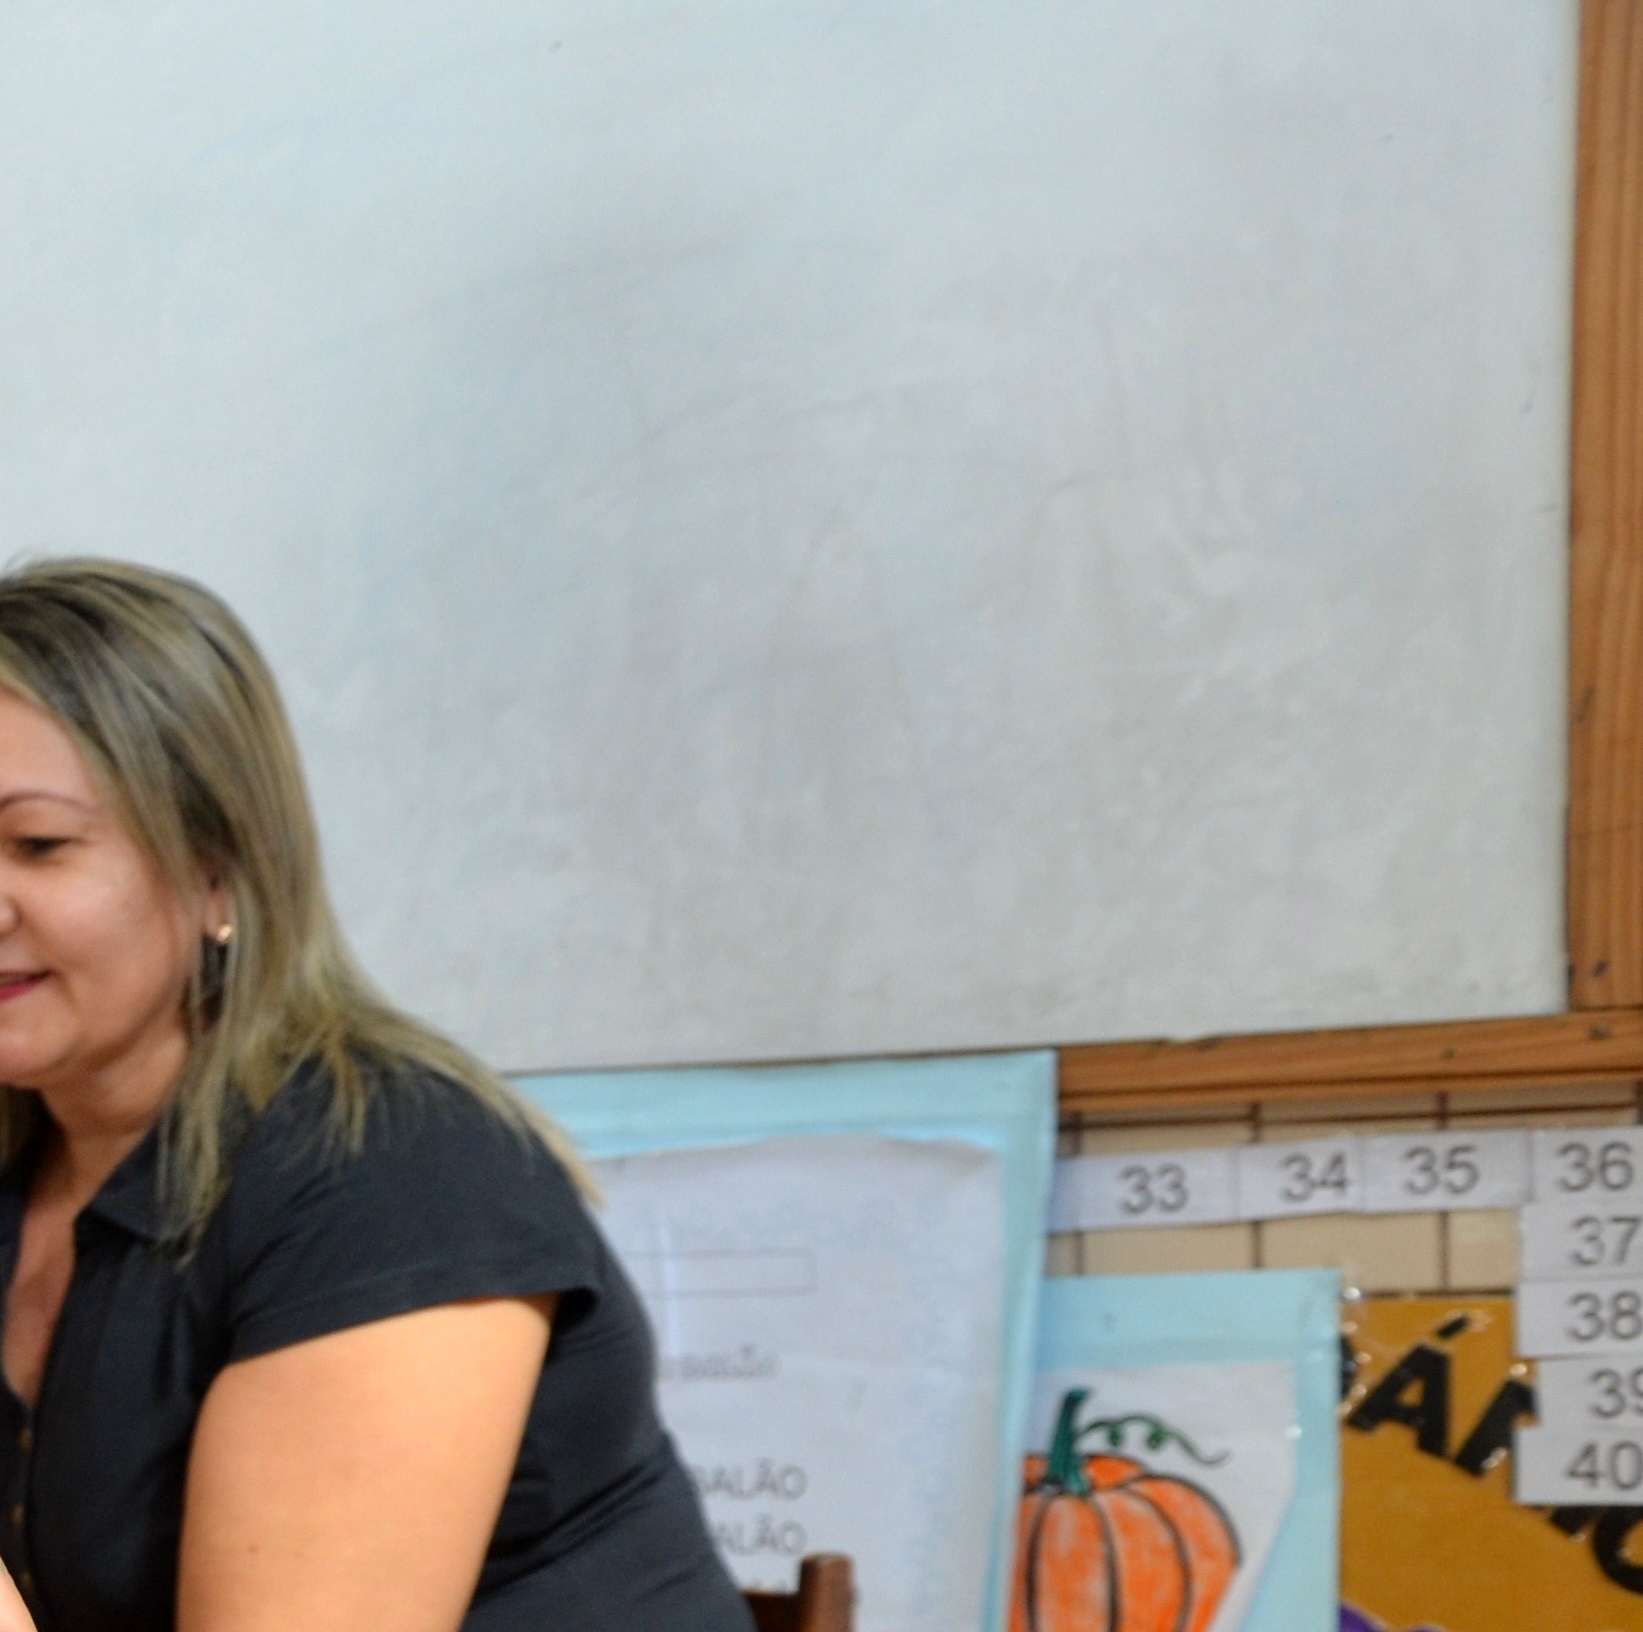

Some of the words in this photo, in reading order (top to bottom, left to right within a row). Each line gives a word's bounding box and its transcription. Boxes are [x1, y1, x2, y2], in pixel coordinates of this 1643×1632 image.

[1120, 1164, 1187, 1215] 33
[1281, 1152, 1348, 1201] 34
[1405, 1144, 1478, 1194] 35
[1558, 1141, 1633, 1192] 36
[1572, 1215, 1643, 1267] 37
[1570, 1291, 1643, 1342] 38
